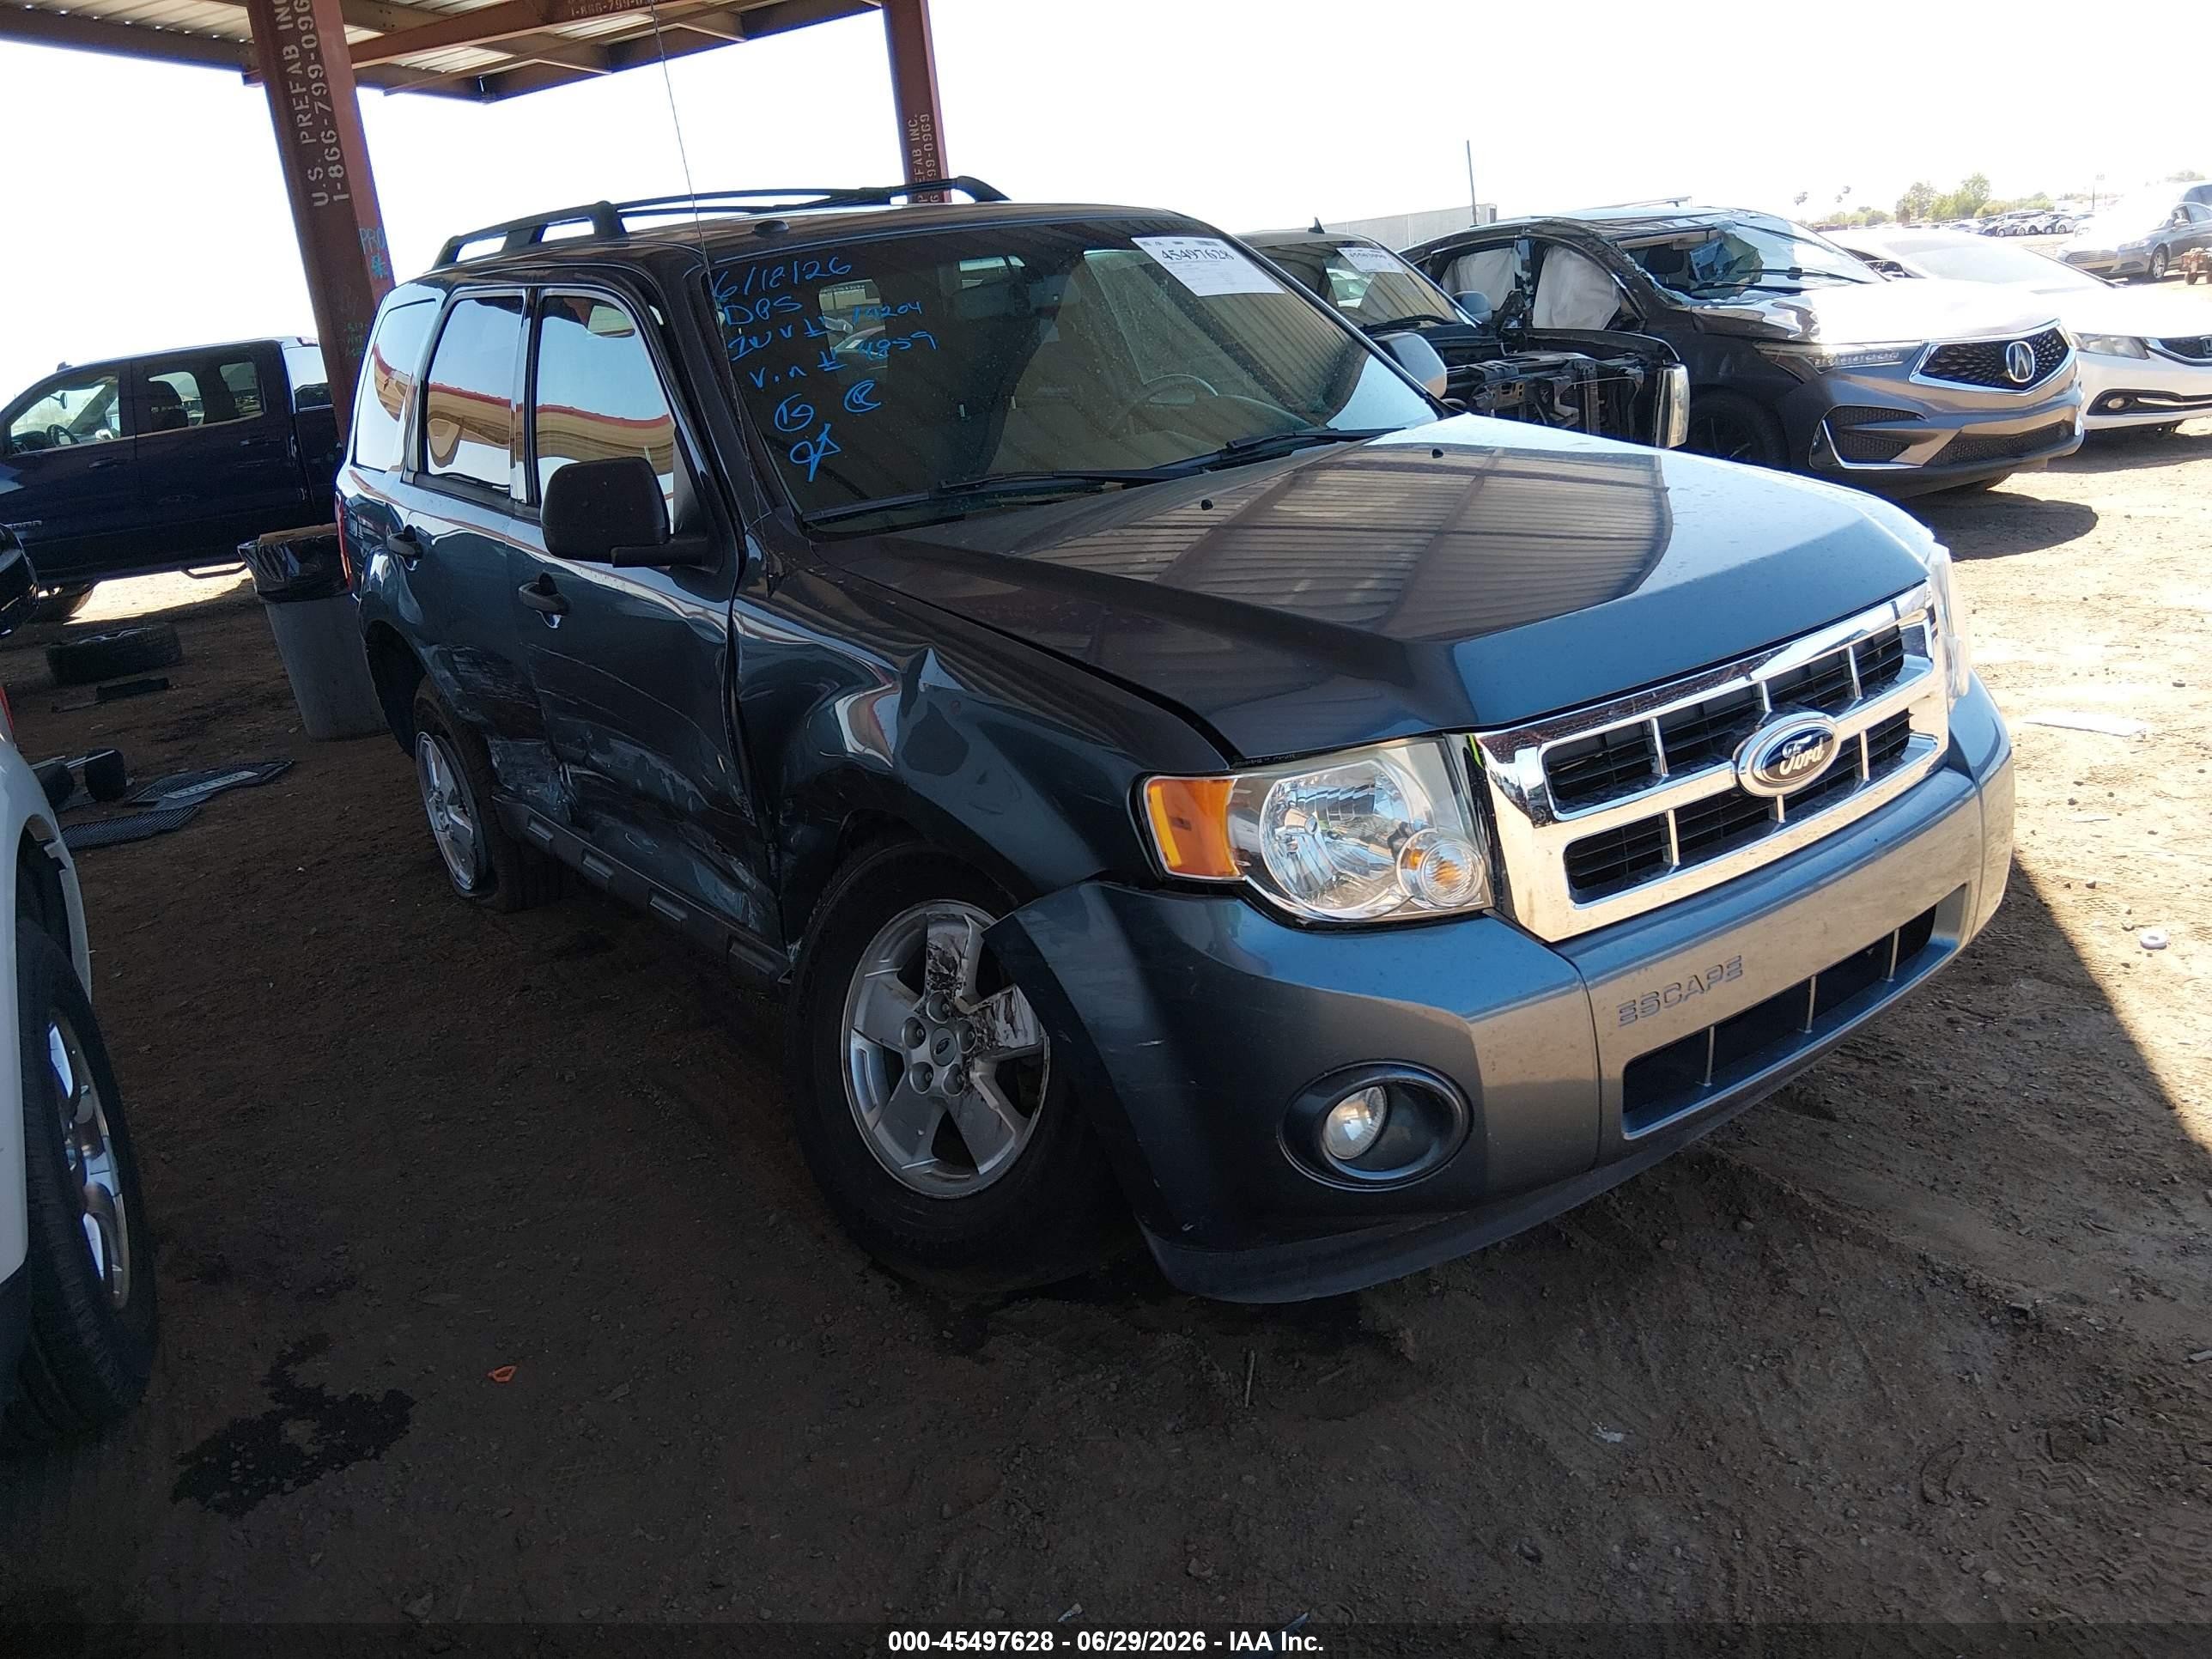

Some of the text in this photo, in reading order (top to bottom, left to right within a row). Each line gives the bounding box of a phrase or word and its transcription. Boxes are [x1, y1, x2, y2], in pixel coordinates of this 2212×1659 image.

[283, 44, 317, 145] PREFAB
[713, 256, 853, 299] 6/18/26
[1779, 735, 1826, 776] Ford
[1616, 953, 1745, 1028] ESCAPE
